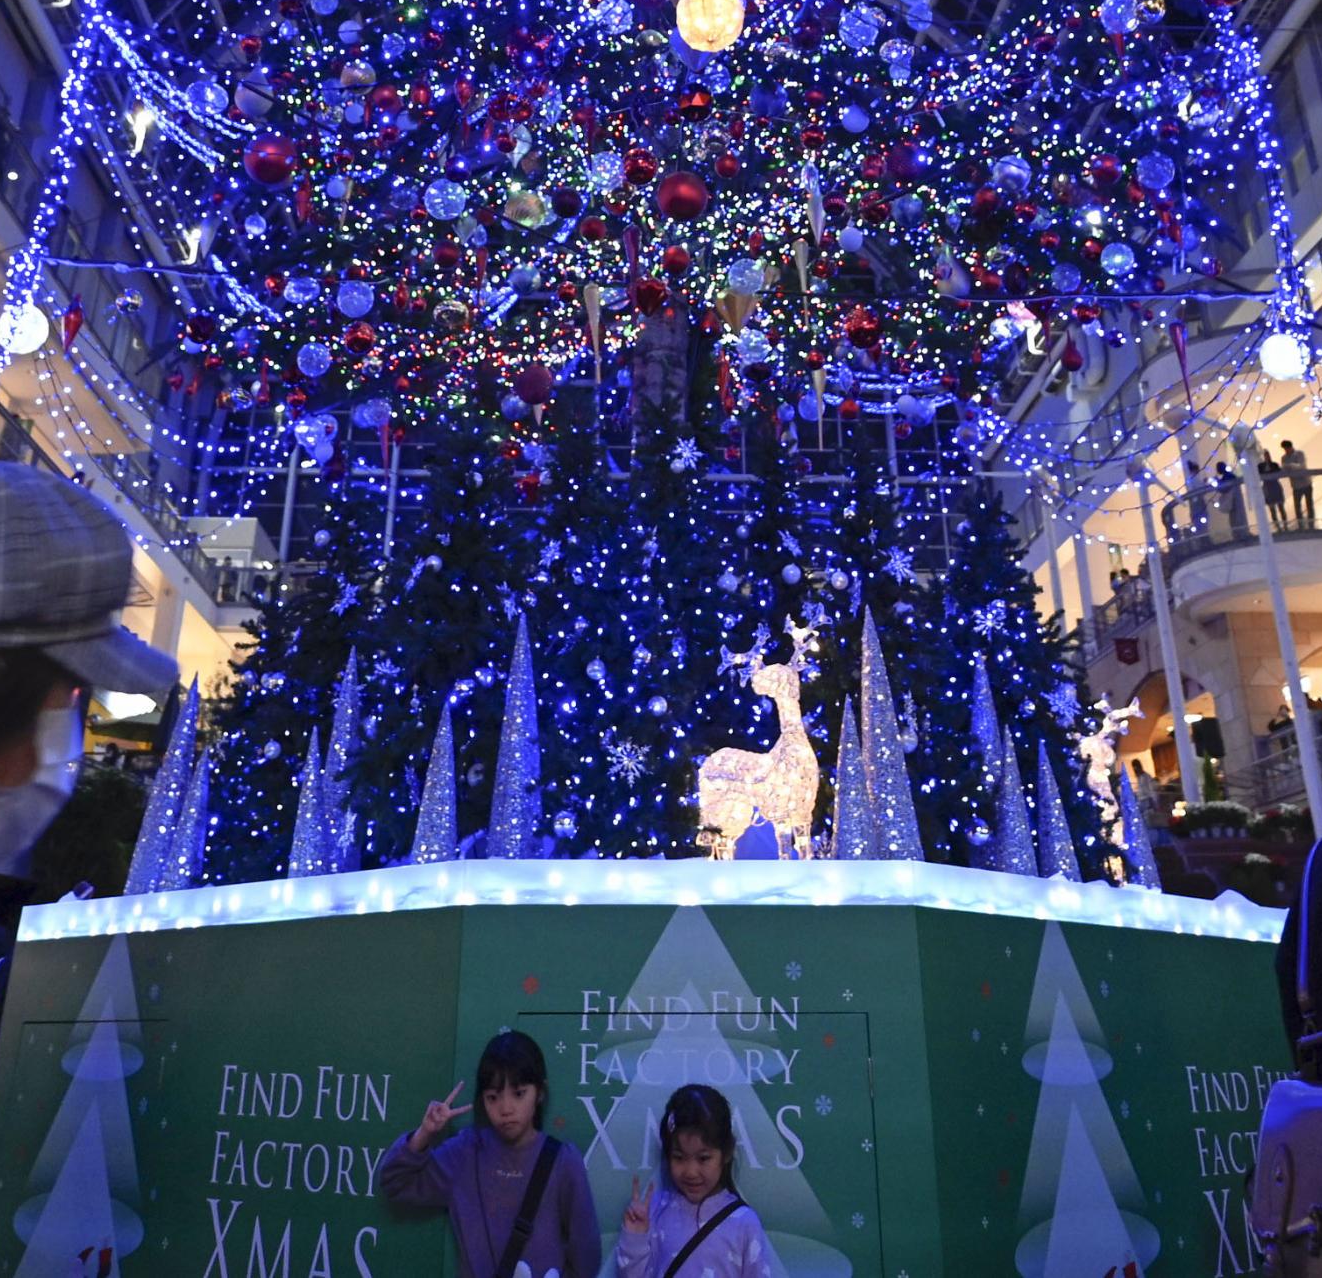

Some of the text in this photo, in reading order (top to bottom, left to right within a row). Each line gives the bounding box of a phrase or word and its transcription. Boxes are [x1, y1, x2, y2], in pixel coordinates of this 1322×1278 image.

[579, 990, 801, 1032] FIND FUN
[577, 1042, 802, 1087] FACTORY
[1185, 1065, 1251, 1114] FIND
[217, 1064, 392, 1122] FIND FUN
[209, 1130, 387, 1198] FACTORY
[1194, 1127, 1259, 1178] FACT
